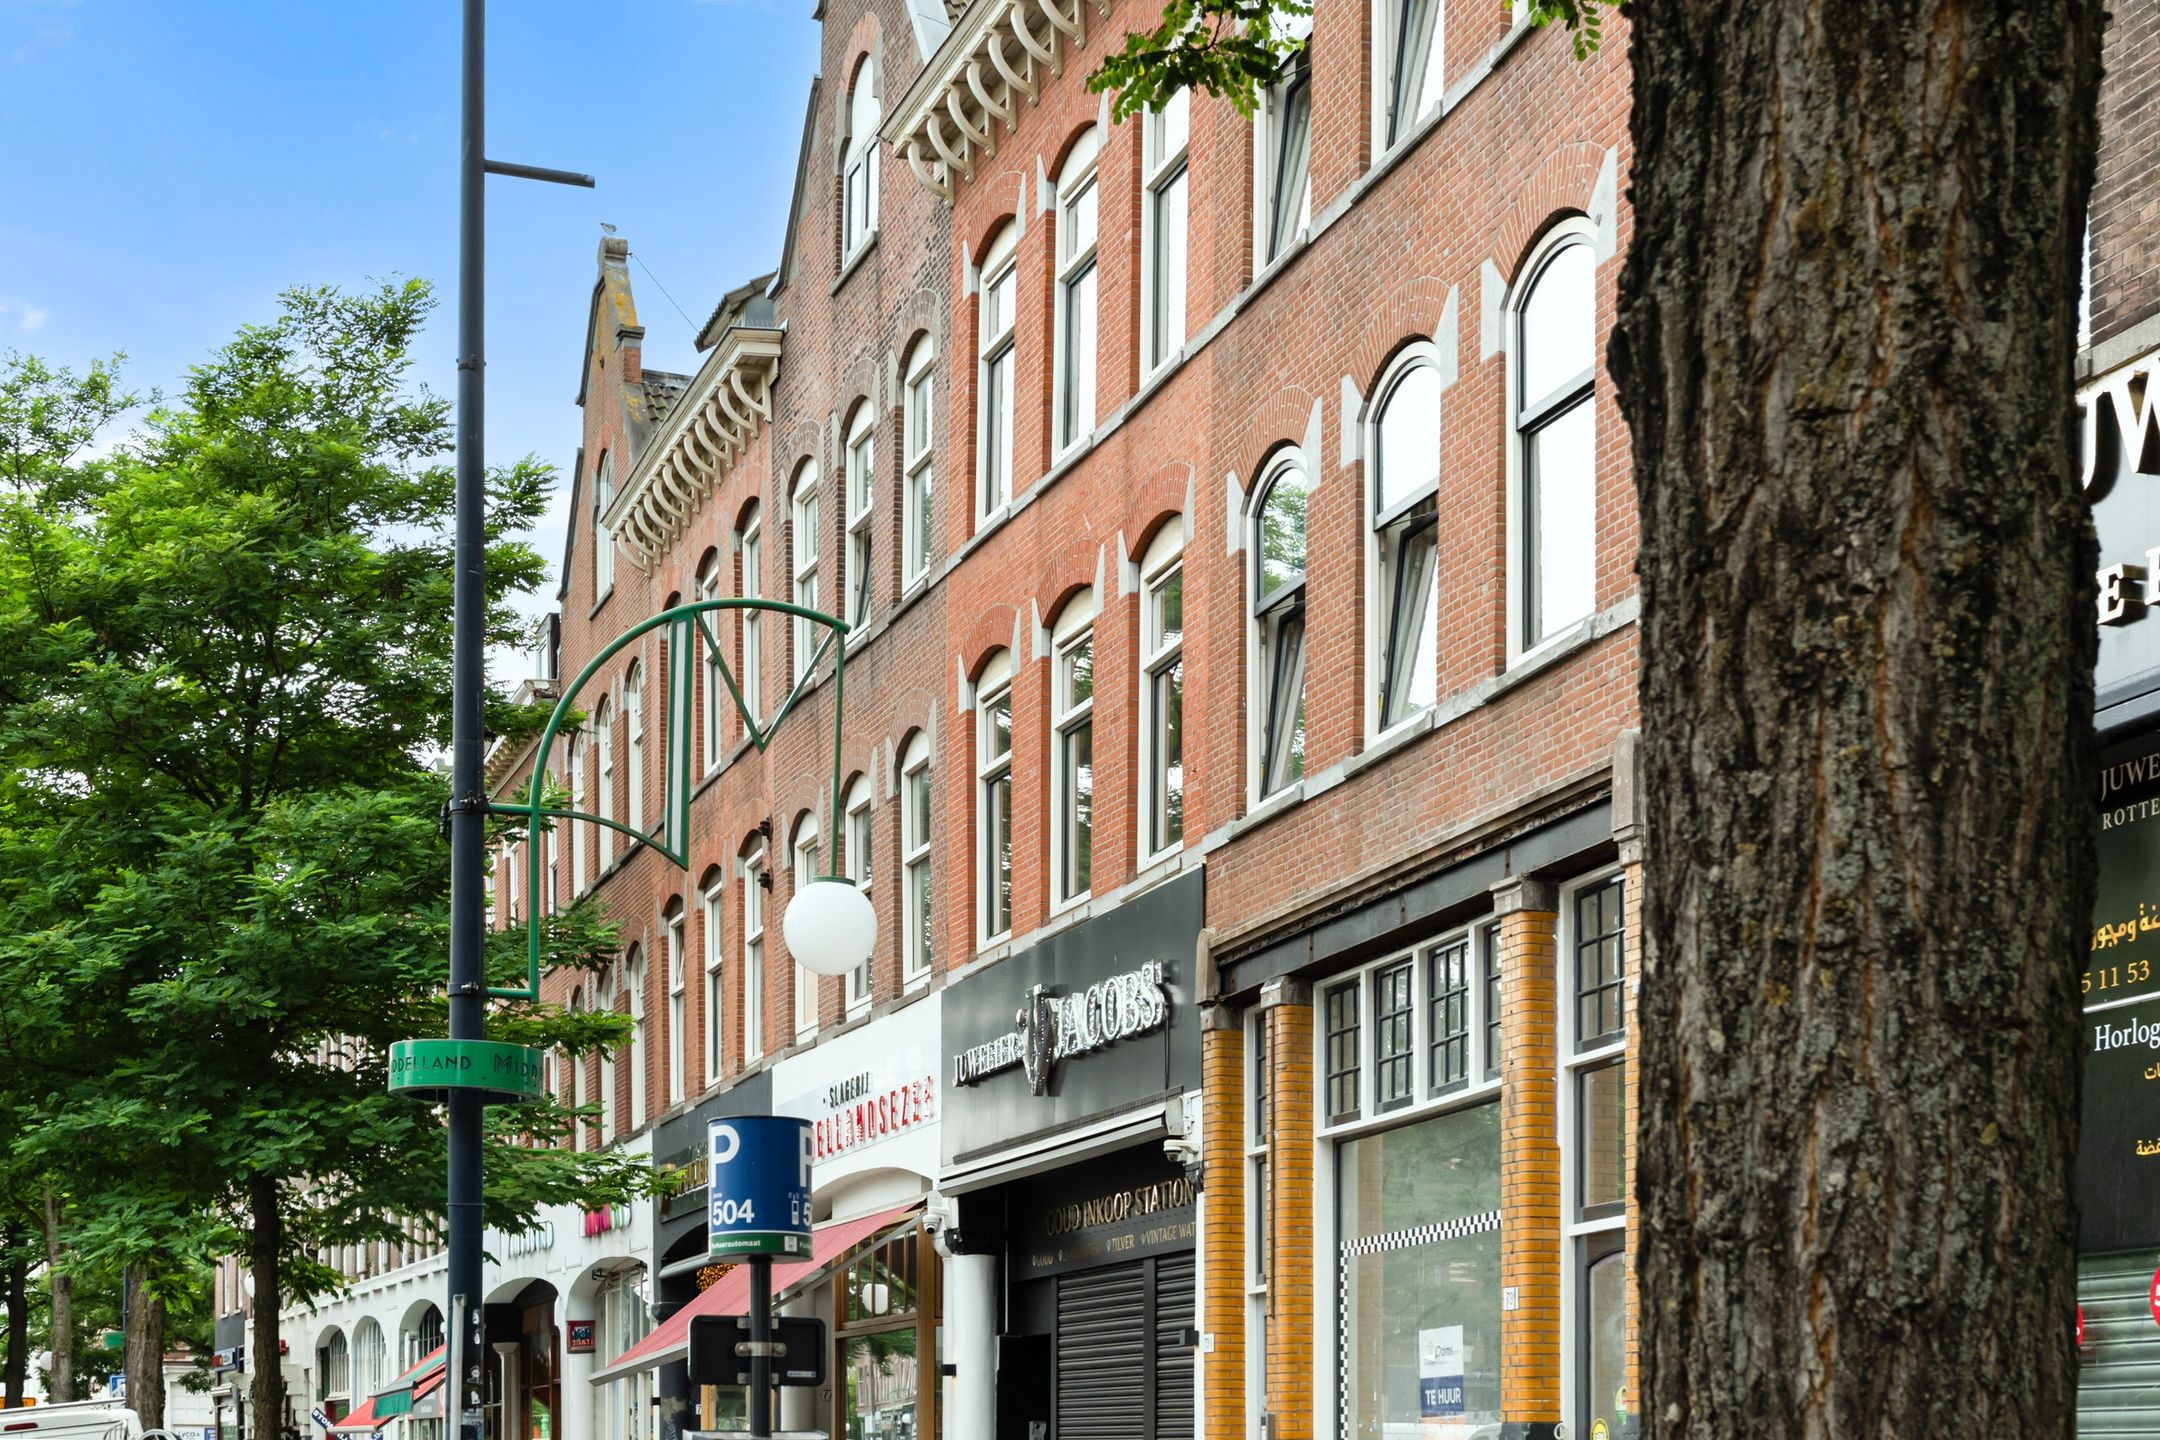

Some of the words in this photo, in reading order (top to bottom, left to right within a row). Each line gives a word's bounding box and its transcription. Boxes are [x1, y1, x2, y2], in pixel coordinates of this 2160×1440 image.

[2100, 753, 2160, 802] JUWE
[2102, 798, 2160, 830] ROTTE
[2100, 966, 2119, 990] 11
[2127, 959, 2150, 984] 53
[2094, 1017, 2160, 1052] Horlog
[829, 1071, 869, 1108] SLAGERIJ
[710, 1124, 740, 1188] P
[712, 1199, 755, 1226] 504
[1083, 1191, 1131, 1228] INKOOP
[1135, 1178, 1194, 1216] STATION
[1147, 1225, 1177, 1244] VINTAGE
[1425, 1389, 1436, 1406] TE
[1438, 1387, 1461, 1405] HUUR
